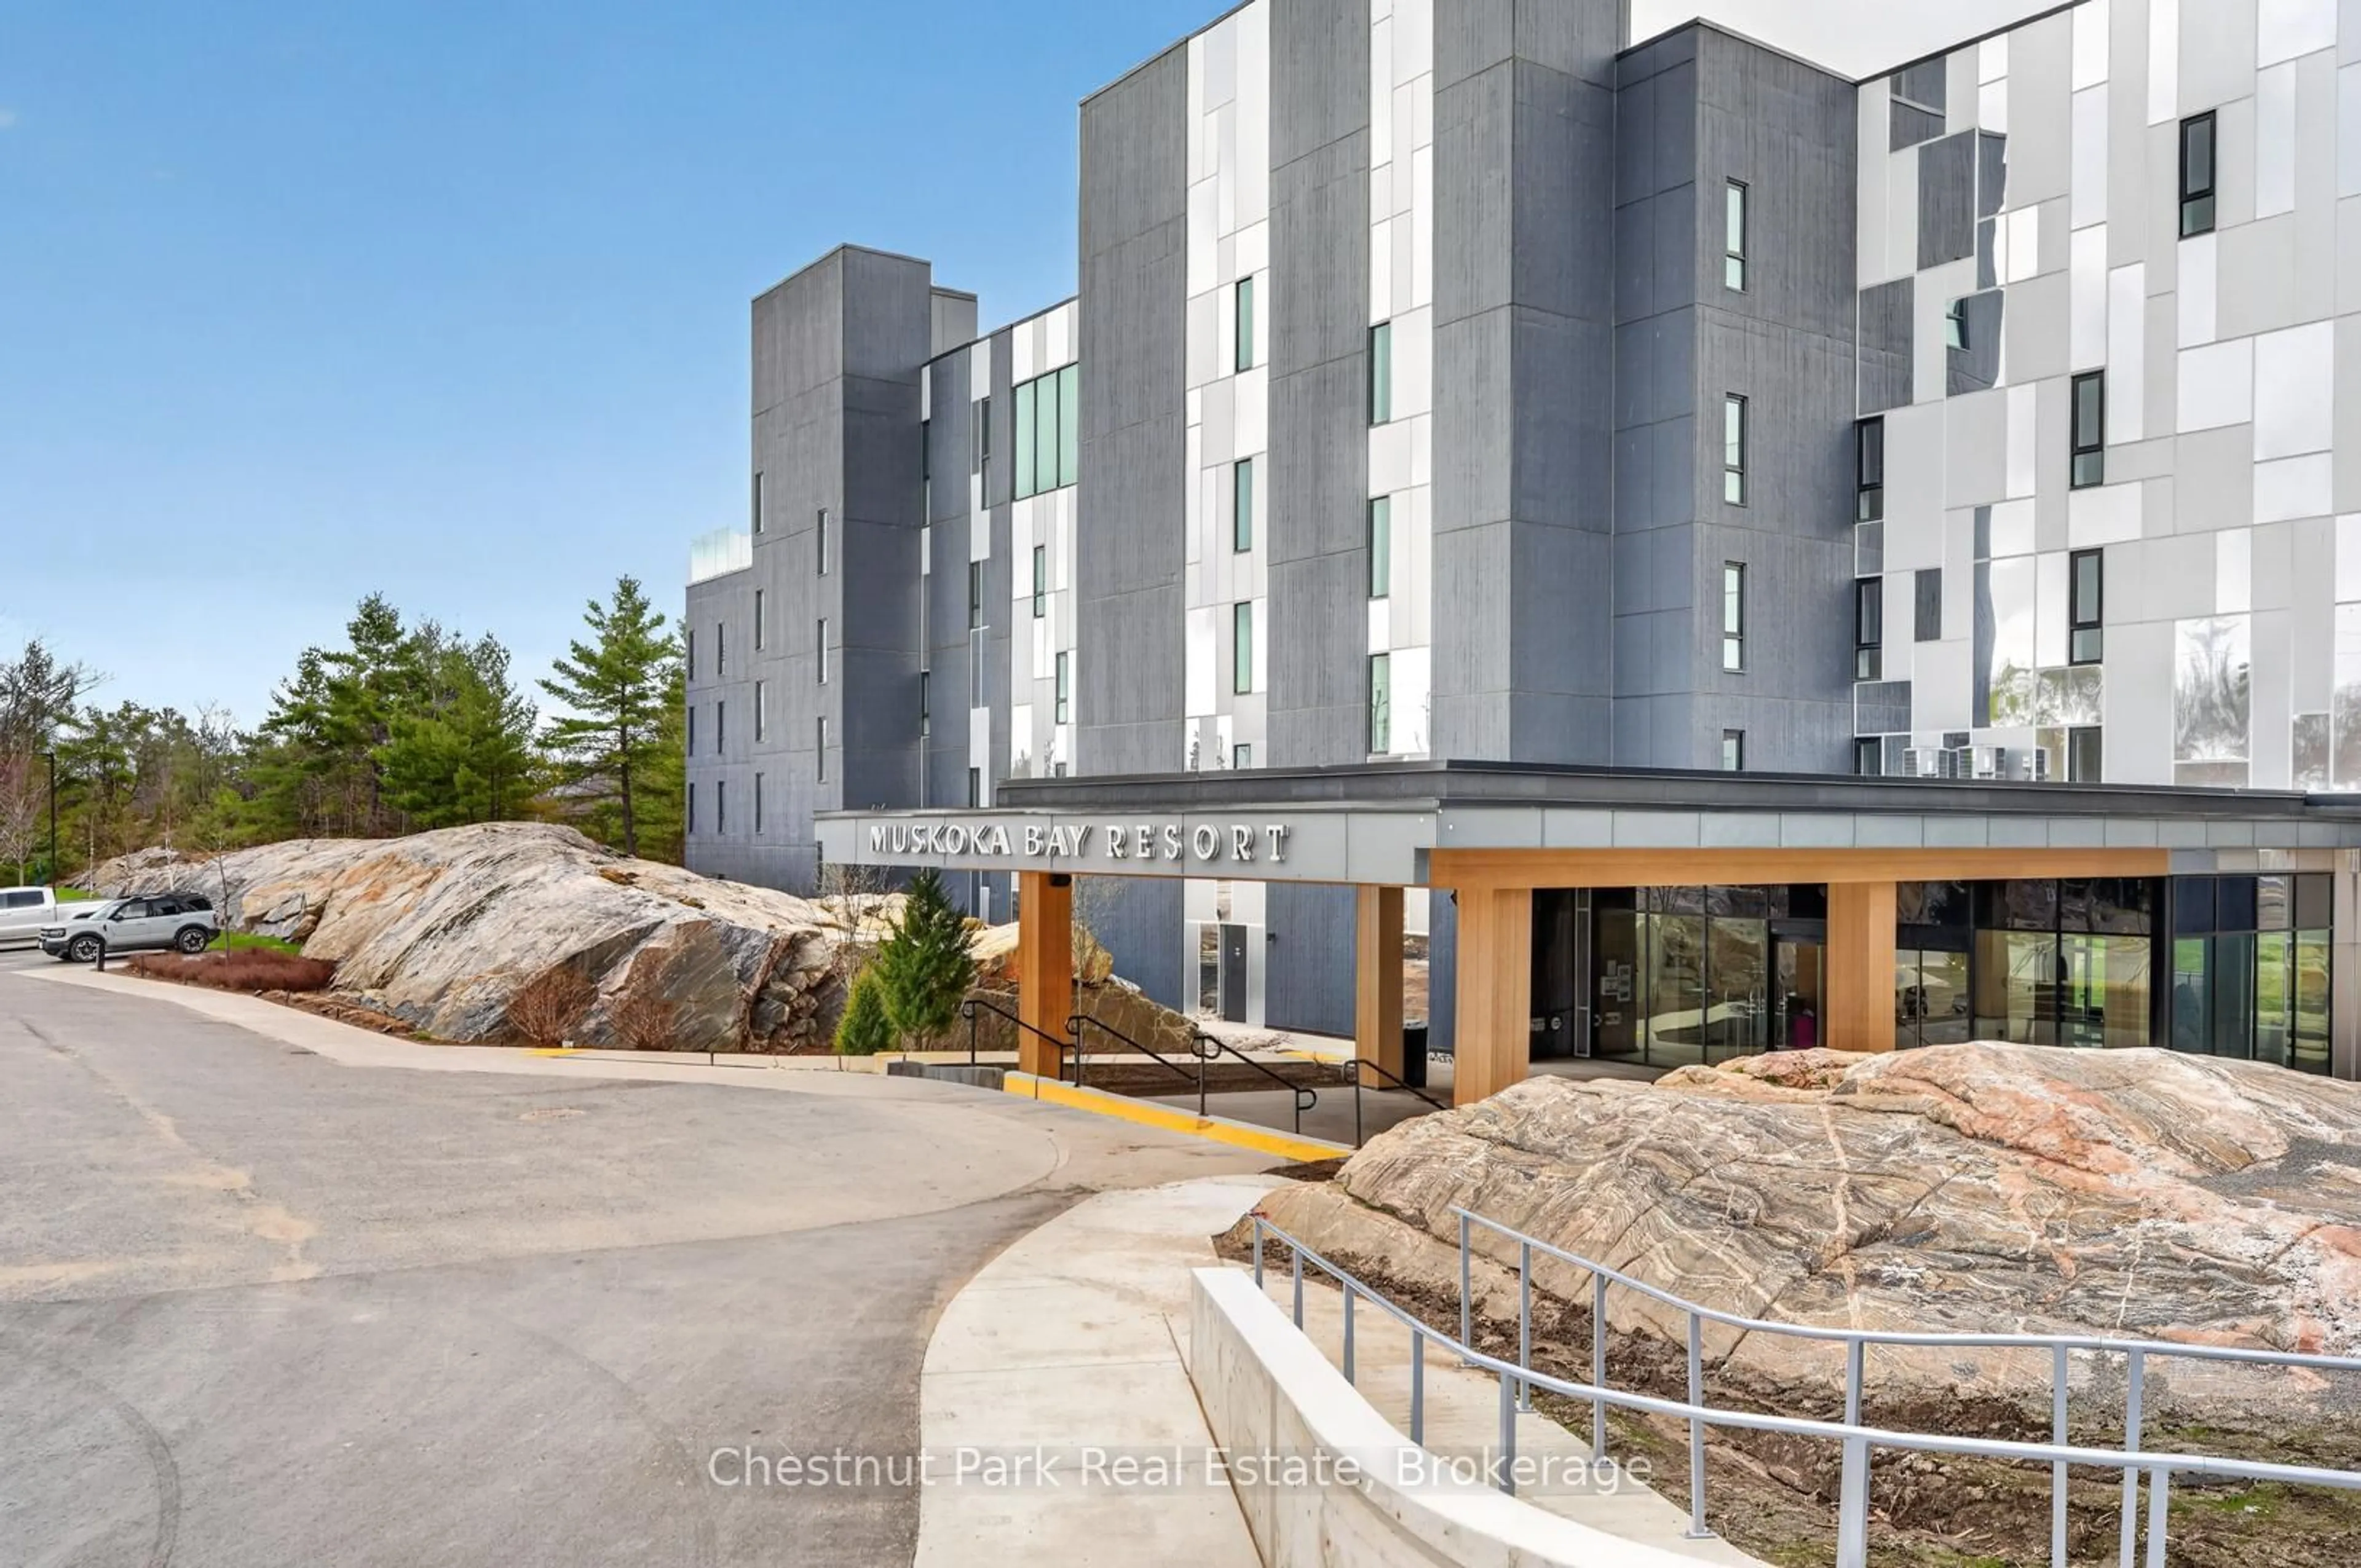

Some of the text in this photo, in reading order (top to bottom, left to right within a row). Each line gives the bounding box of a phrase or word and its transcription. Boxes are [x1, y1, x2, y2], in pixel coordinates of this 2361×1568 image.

[869, 824, 1289, 861] MUSKOKA BAY RESORT
